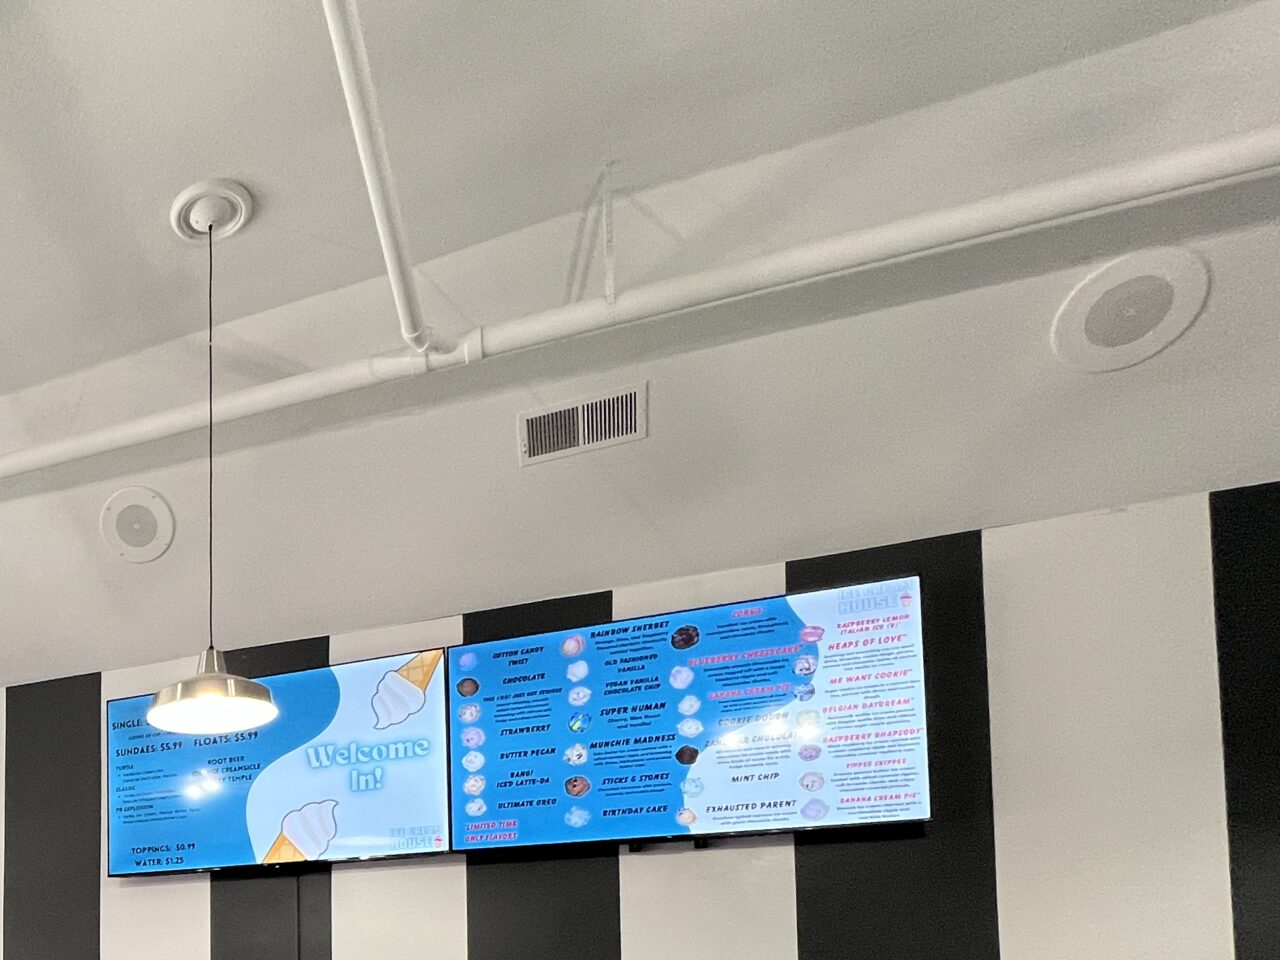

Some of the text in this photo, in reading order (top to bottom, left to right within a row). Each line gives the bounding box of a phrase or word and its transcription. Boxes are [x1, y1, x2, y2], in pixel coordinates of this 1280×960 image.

[839, 594, 898, 615] HOUSE
[590, 620, 669, 639] RAINBOW SHERBET
[828, 640, 860, 650] HEAPS
[863, 638, 875, 646] OF
[492, 646, 544, 659] COTTON CANDY
[620, 654, 658, 663] FASHIONED
[618, 665, 645, 673] VANILLA
[503, 673, 545, 684] CHOCOLATE
[606, 676, 659, 688] VEGAN VANILLA
[846, 674, 872, 682] WANT
[875, 670, 908, 679] COOKIE
[604, 686, 642, 695] CHOCOLATE
[600, 702, 666, 716] SUPER HUMAN
[822, 698, 910, 713] BELGIAN DAYDREAM
[112, 719, 143, 730] SINGLE:
[719, 712, 789, 726] COOKIE DOUGH
[500, 724, 551, 736] STRAWBERRY
[823, 728, 920, 743] RASPBERRY RHAPSODY
[194, 731, 258, 747] FLOATS: $5.99
[590, 733, 676, 749] MUNCHIE MADNESS
[116, 741, 182, 757] SUNDAES: $5.99
[306, 739, 430, 769] Welcome
[500, 748, 556, 759] BUTTER PECAN
[208, 757, 227, 765] ROOT
[228, 774, 252, 782] TEMPLE
[350, 766, 384, 792] In!
[496, 780, 513, 788] ICED
[602, 777, 629, 785] STICKS
[639, 773, 670, 781] STONES
[731, 773, 780, 783] MINT CHIP
[498, 800, 534, 809] ULTIMATE
[603, 805, 668, 816] BIRTHDAY CAKE
[706, 800, 797, 813] EXHAUSTED PARENT
[390, 836, 433, 849] HOUSE
[486, 833, 517, 841] FLAVORS
[132, 843, 196, 854] TOPPINGS: $0.99
[166, 856, 184, 865] $1.25
